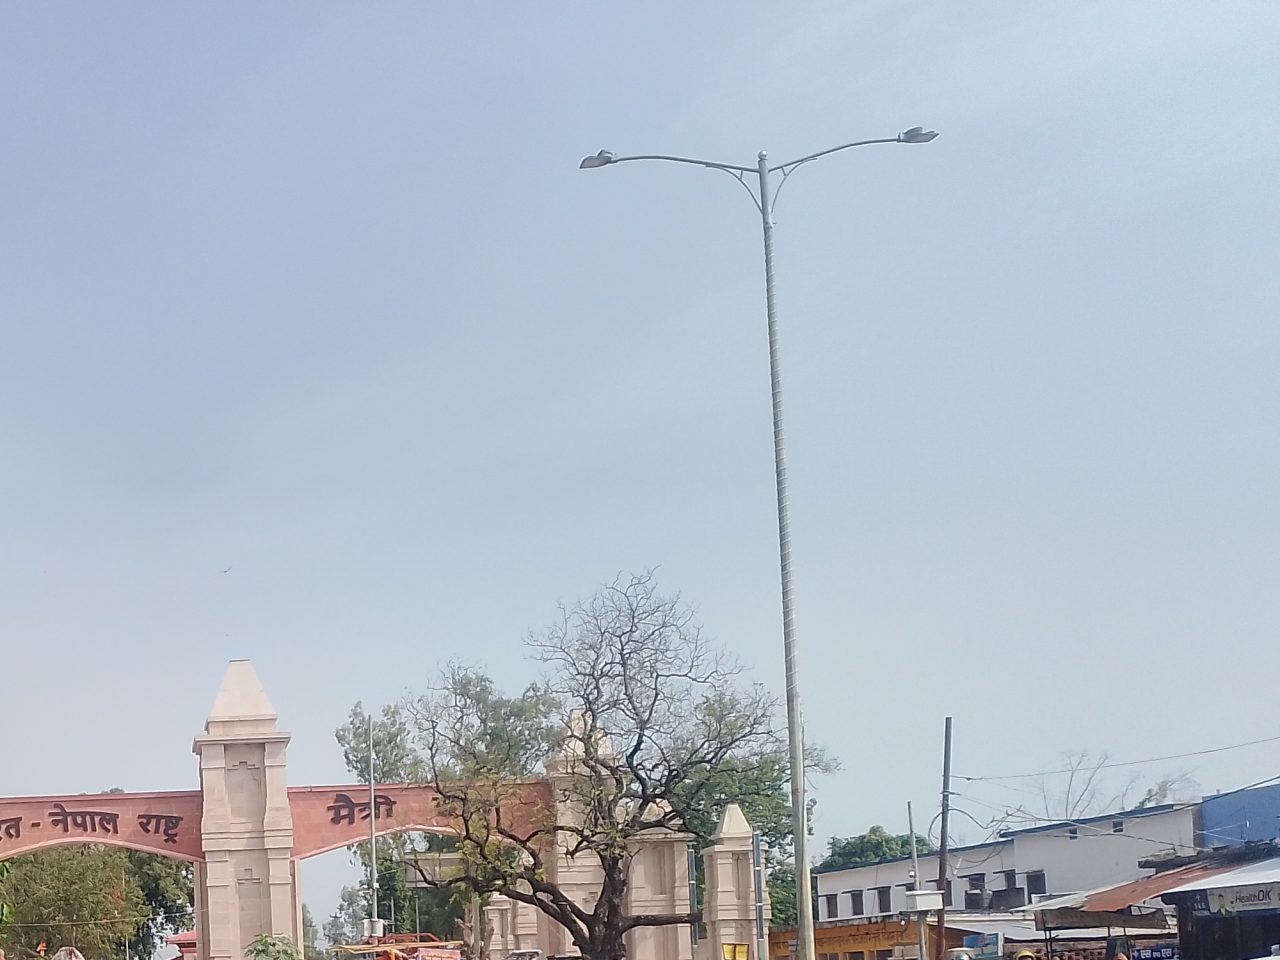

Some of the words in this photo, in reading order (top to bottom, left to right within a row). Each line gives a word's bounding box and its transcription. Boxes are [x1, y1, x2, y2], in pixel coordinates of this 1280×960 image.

[48, 804, 120, 834] नेपाल
[137, 814, 183, 844] राष्ट्र
[327, 793, 397, 825] मैत्री
